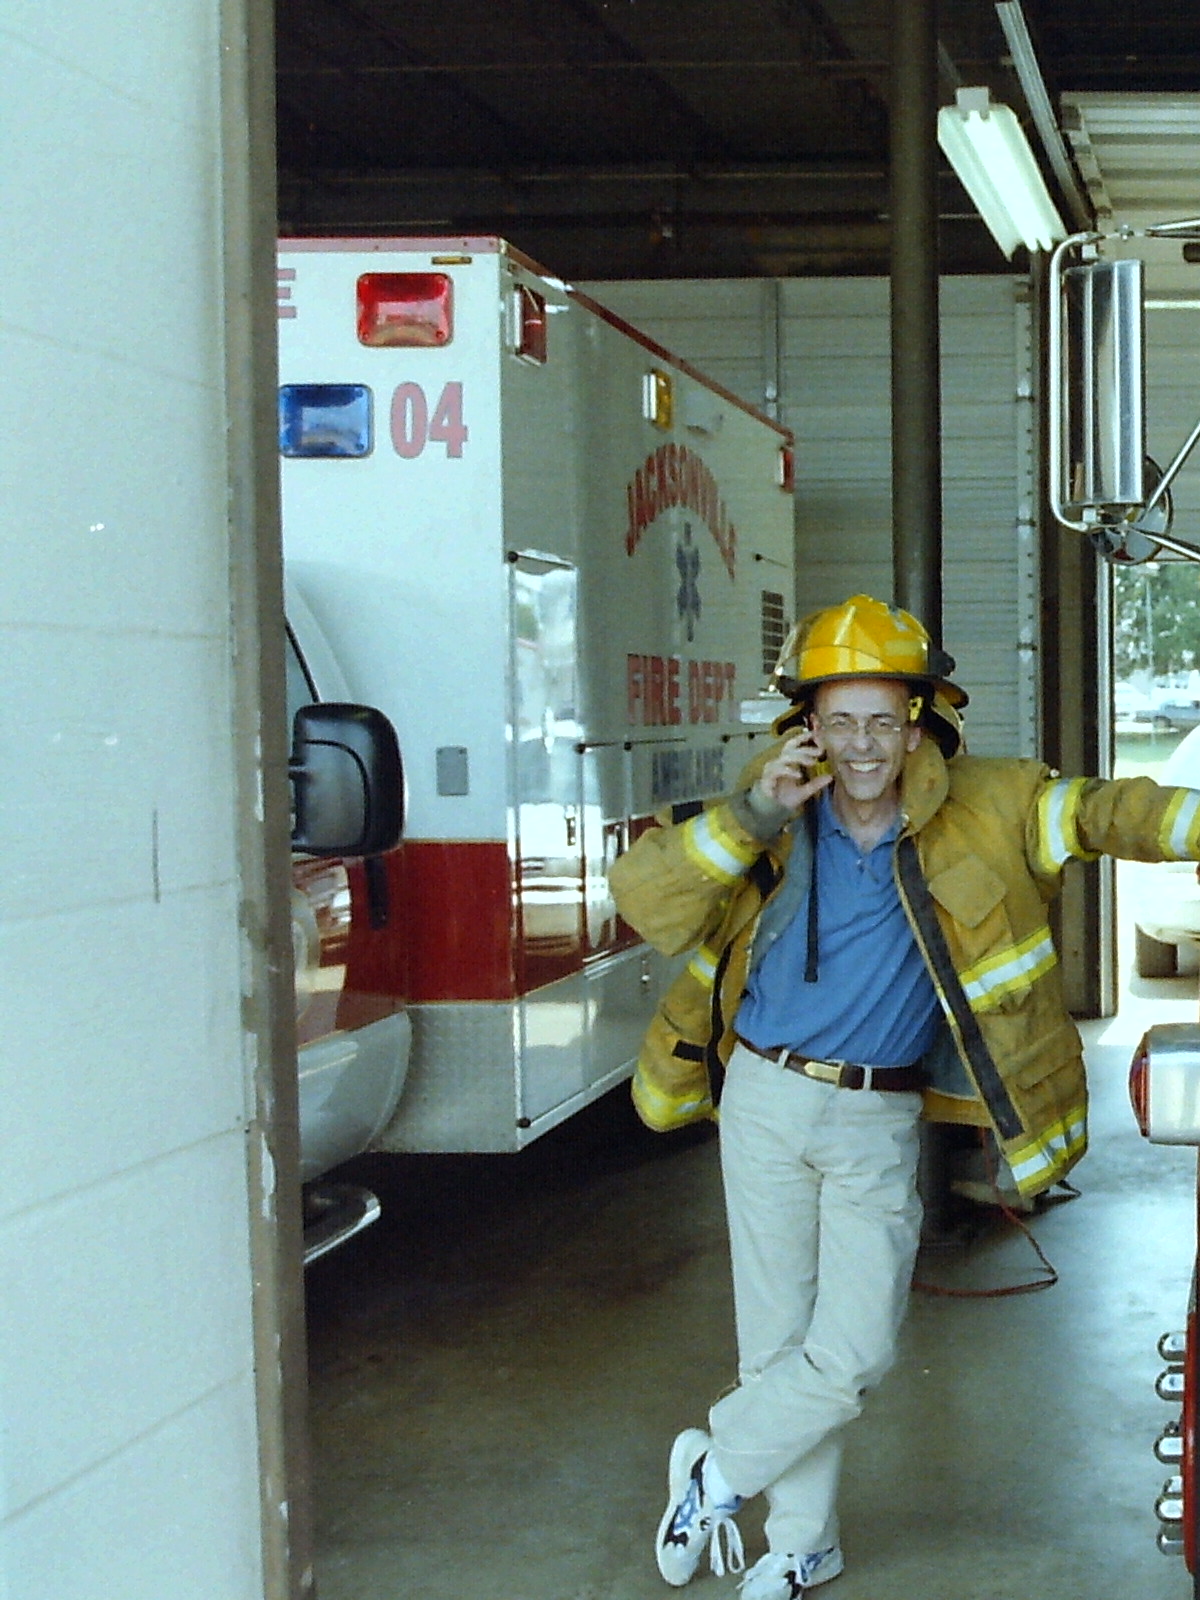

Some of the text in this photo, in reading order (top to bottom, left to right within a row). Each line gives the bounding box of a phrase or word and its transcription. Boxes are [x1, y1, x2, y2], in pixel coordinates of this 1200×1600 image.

[390, 381, 468, 458] 04
[627, 653, 736, 726] FIRE DEPT
